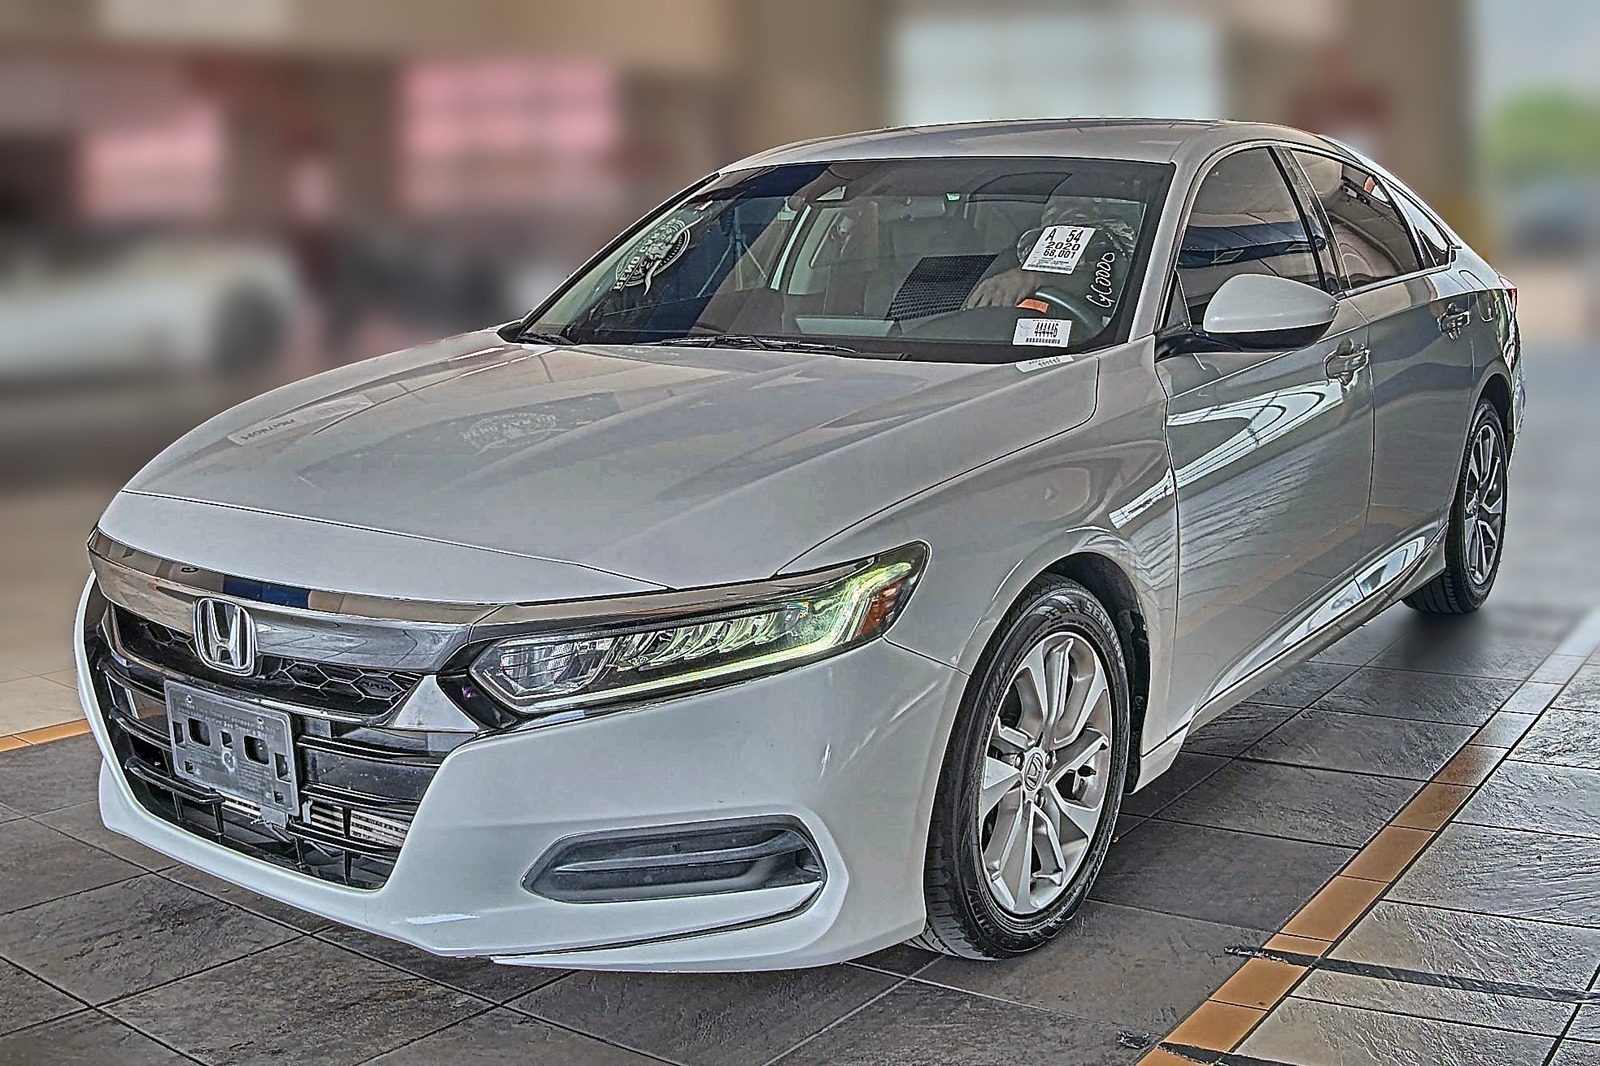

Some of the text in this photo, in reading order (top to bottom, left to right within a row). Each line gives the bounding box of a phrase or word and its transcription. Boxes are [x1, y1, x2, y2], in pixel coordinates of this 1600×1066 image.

[1045, 228, 1085, 243] A 54
[1045, 241, 1081, 252] 2020
[1043, 248, 1076, 260] 68,001
